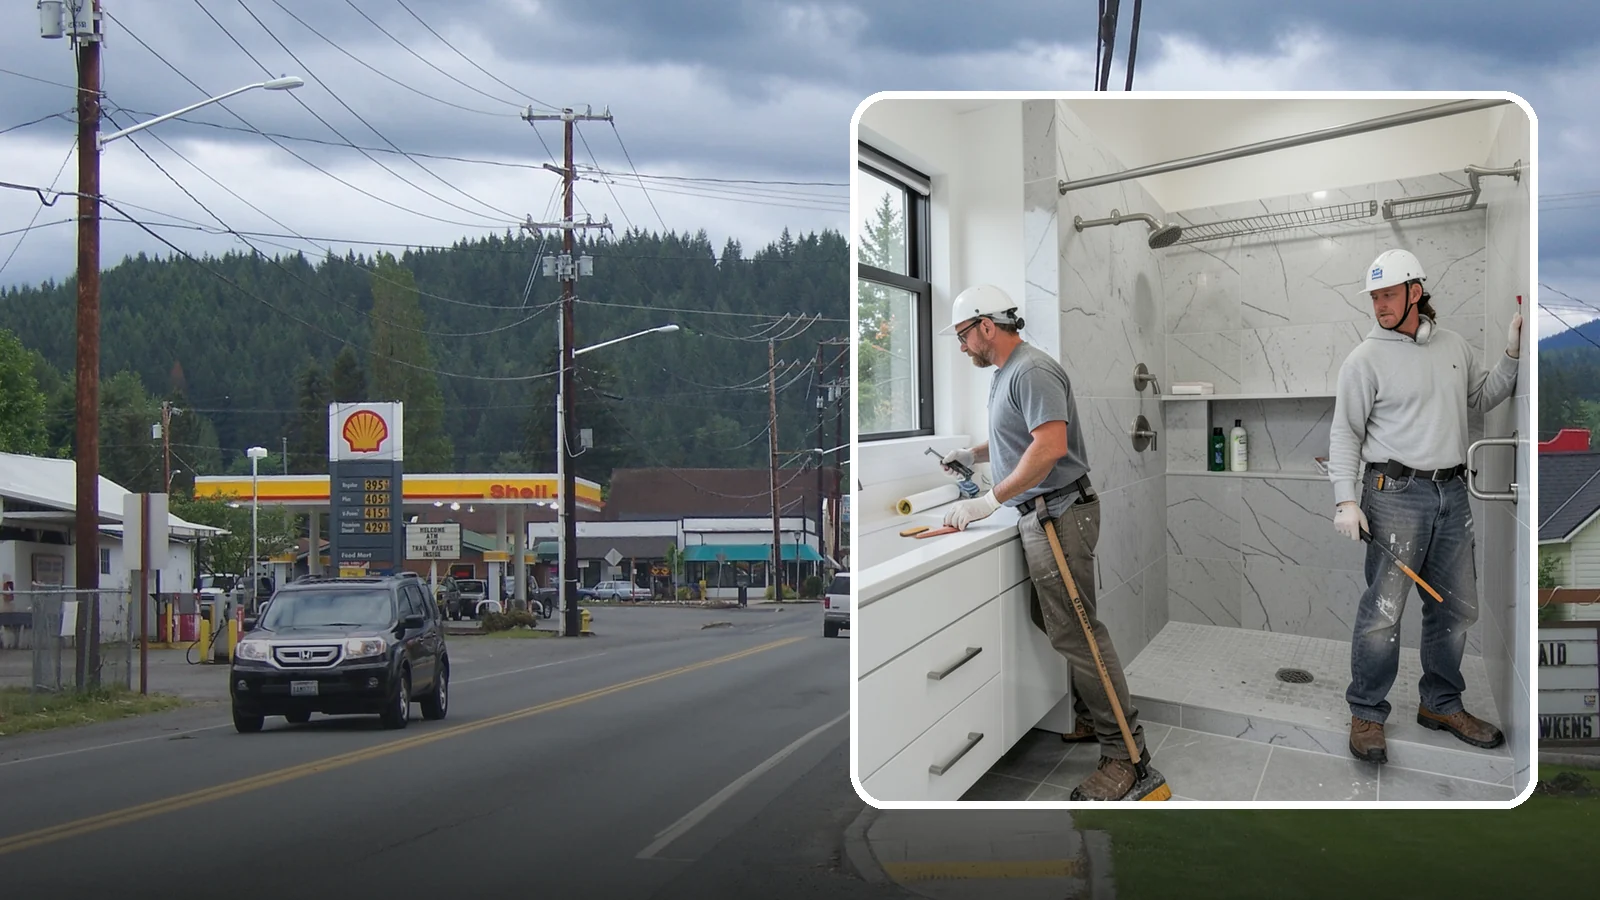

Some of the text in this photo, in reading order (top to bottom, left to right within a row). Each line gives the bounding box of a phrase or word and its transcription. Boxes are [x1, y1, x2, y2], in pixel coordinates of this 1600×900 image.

[365, 480, 383, 490] 395
[490, 484, 547, 499] Shell
[365, 494, 383, 504] 405
[365, 508, 383, 518] 415
[365, 522, 383, 533] 429
[1538, 643, 1567, 665] AID
[1538, 716, 1592, 739] WKENS
